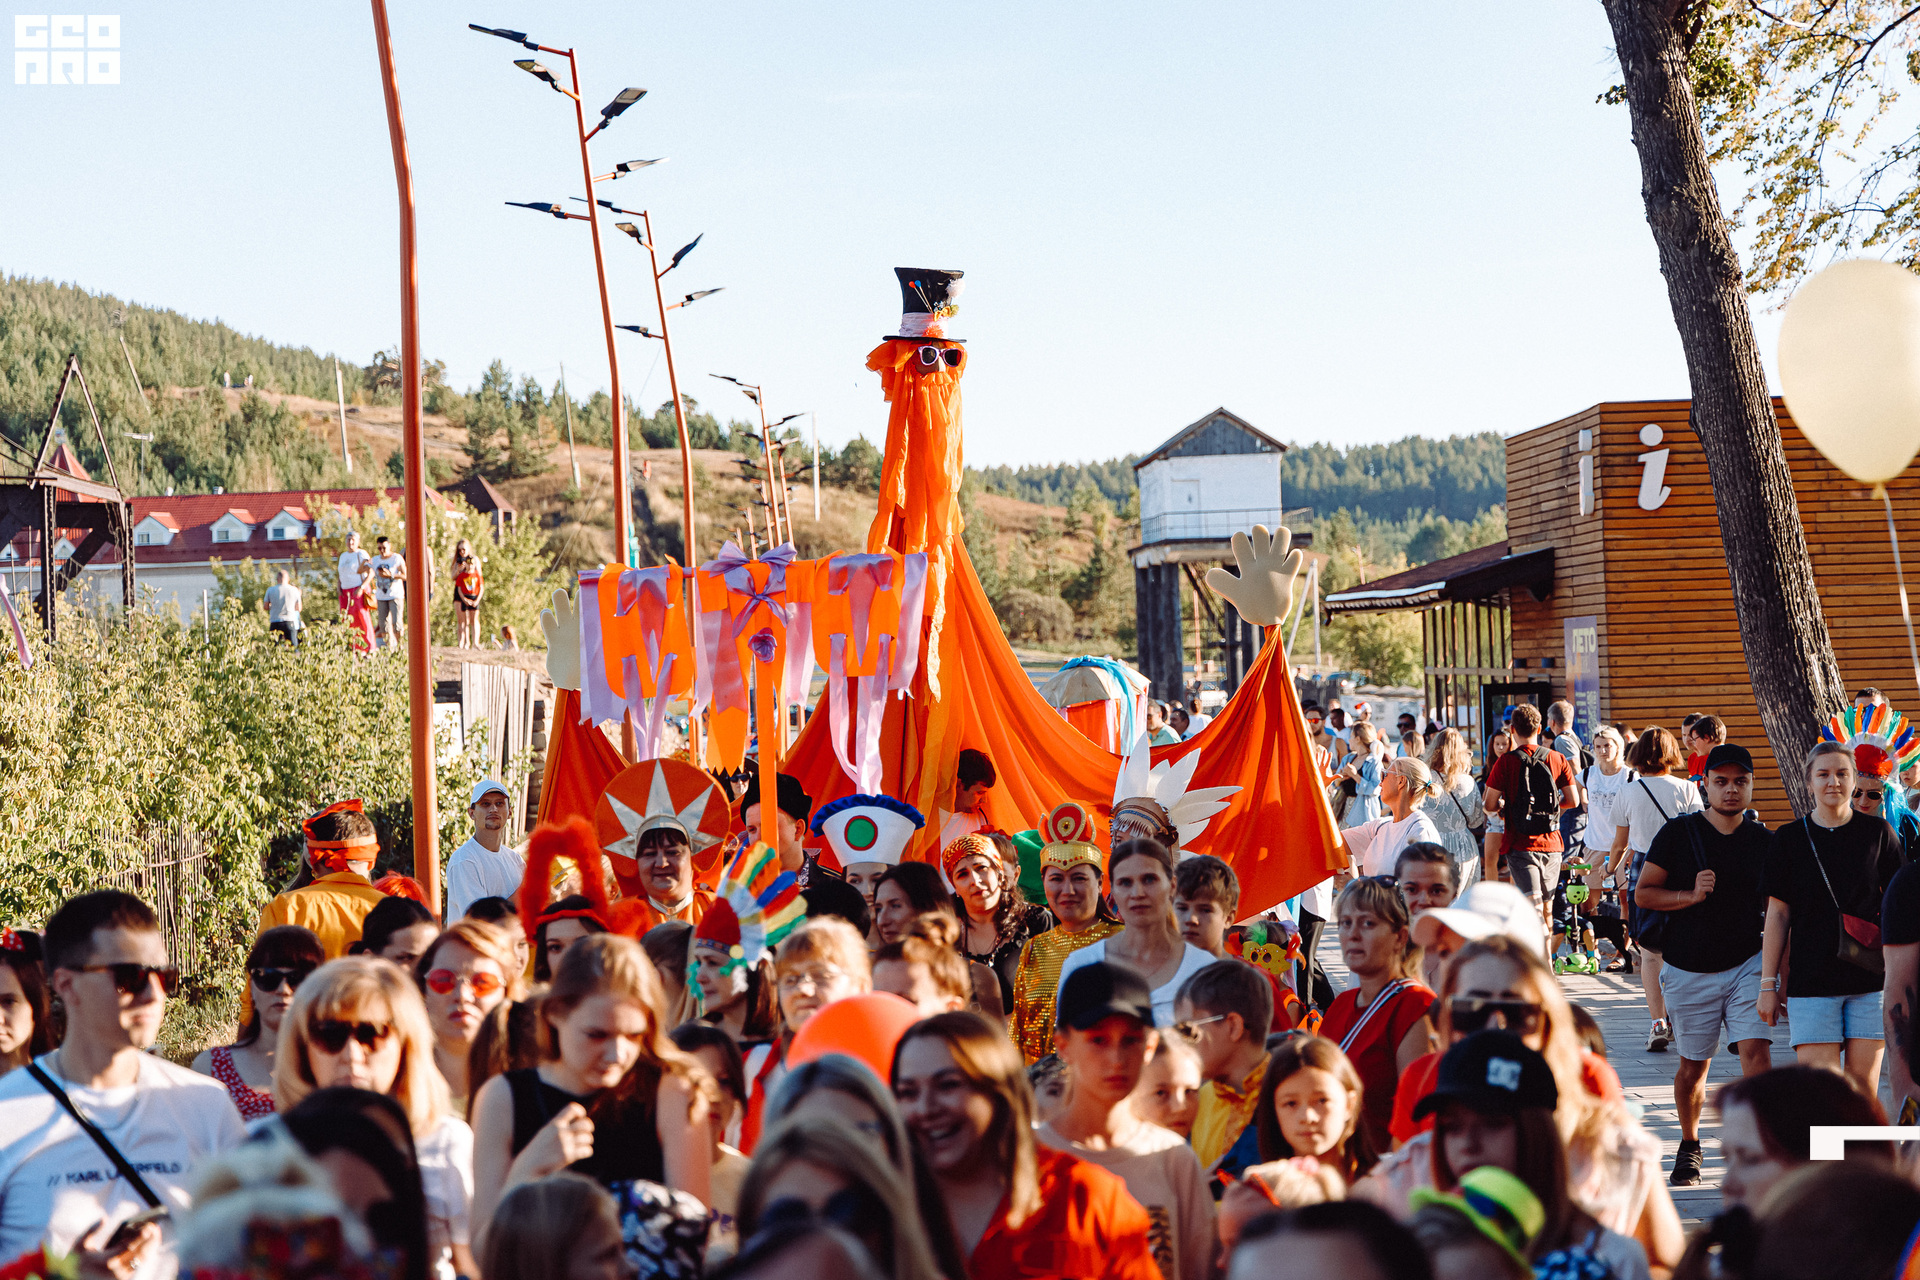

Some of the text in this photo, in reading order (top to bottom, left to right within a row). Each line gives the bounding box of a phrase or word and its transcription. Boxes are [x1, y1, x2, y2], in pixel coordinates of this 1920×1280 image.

[1638, 424, 1671, 510] i
[66, 1172, 103, 1183] KARL
[106, 1163, 181, 1180] LRFELD
